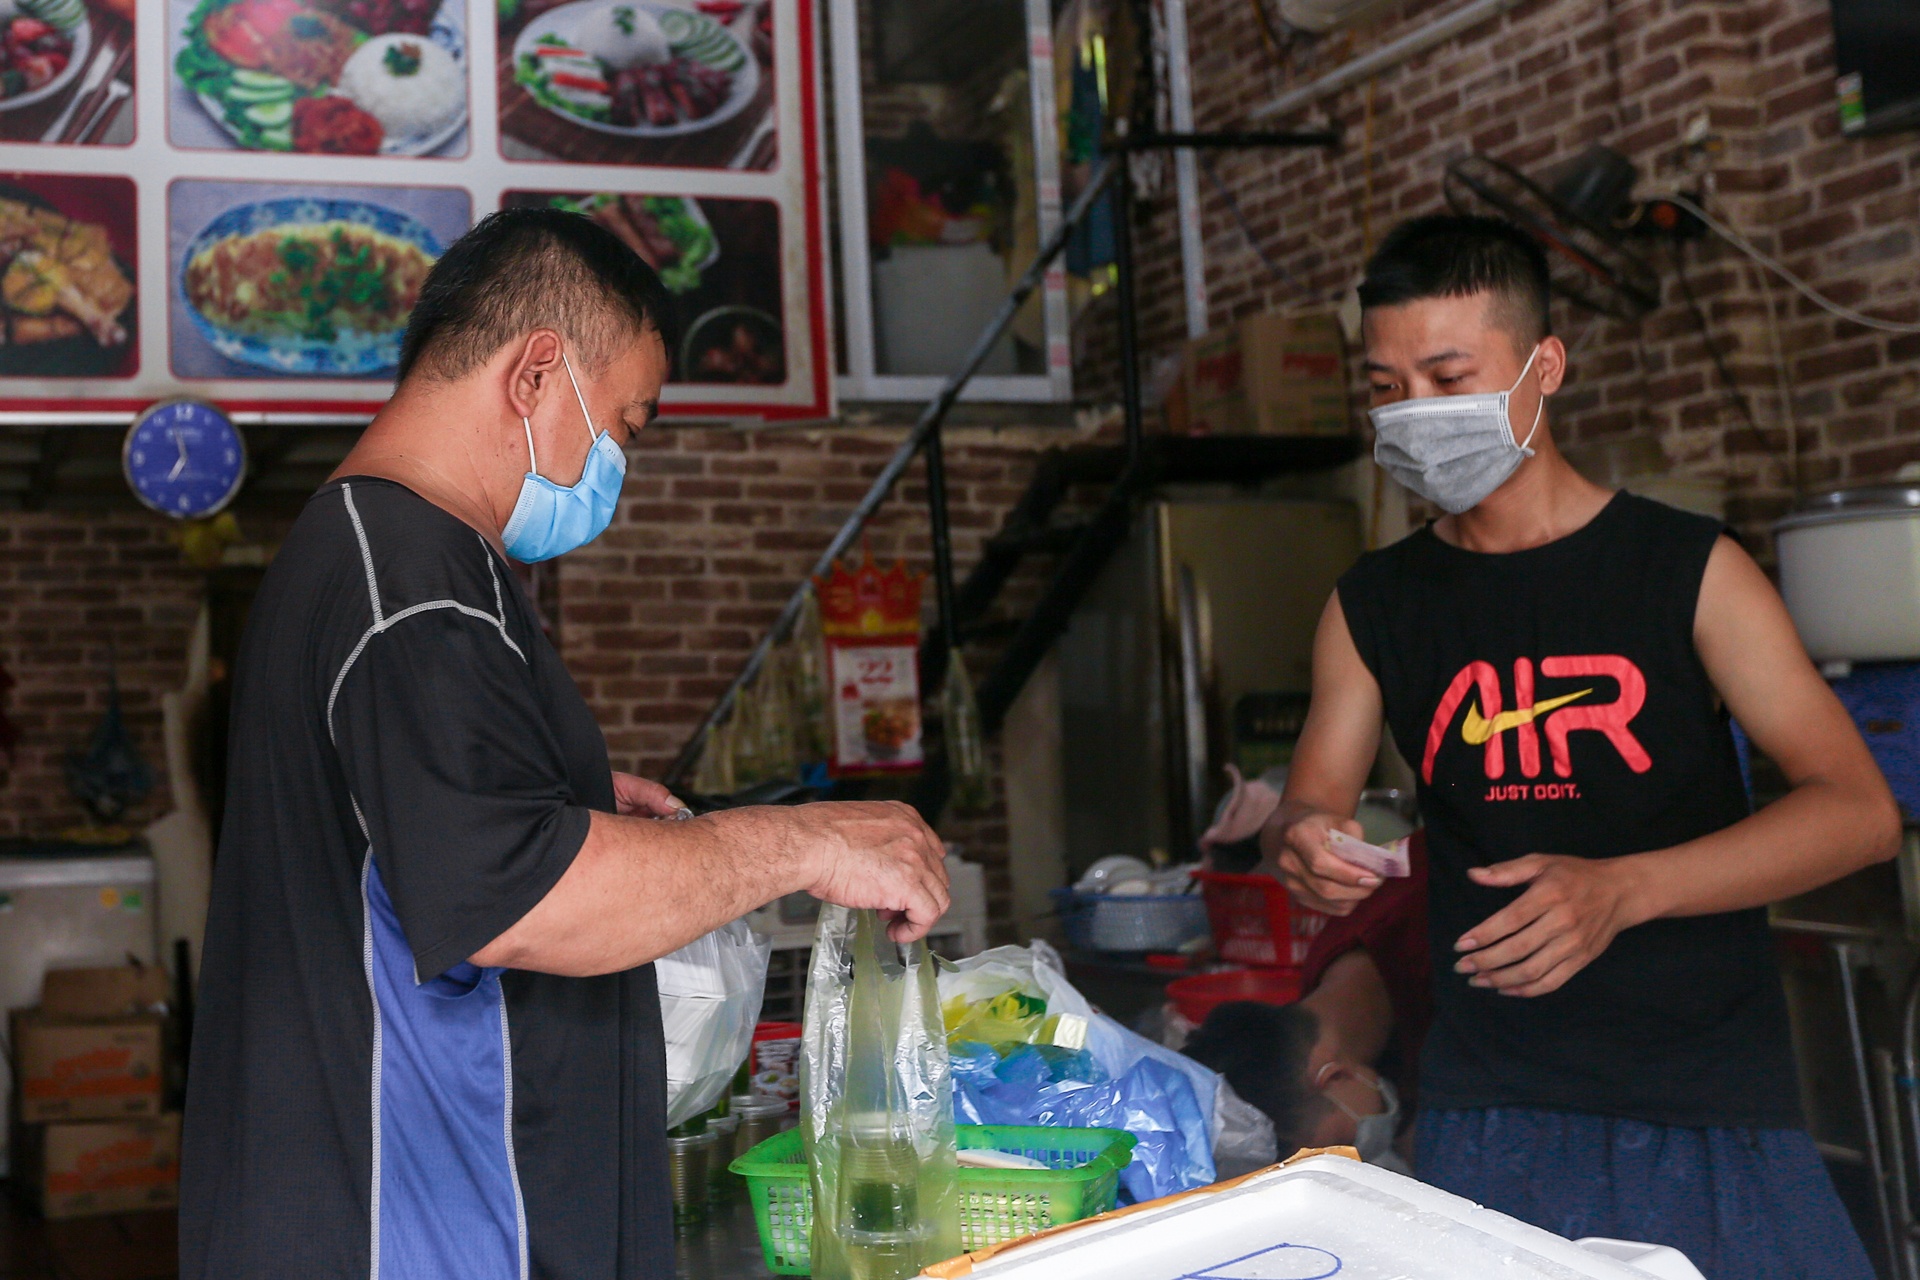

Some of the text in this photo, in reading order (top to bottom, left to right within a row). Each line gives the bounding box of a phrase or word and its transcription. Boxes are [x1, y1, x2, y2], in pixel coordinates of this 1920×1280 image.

[175, 404, 194, 420] 12
[858, 659, 894, 684] 22
[1421, 654, 1652, 786] AIR
[1484, 784, 1530, 802] JUST
